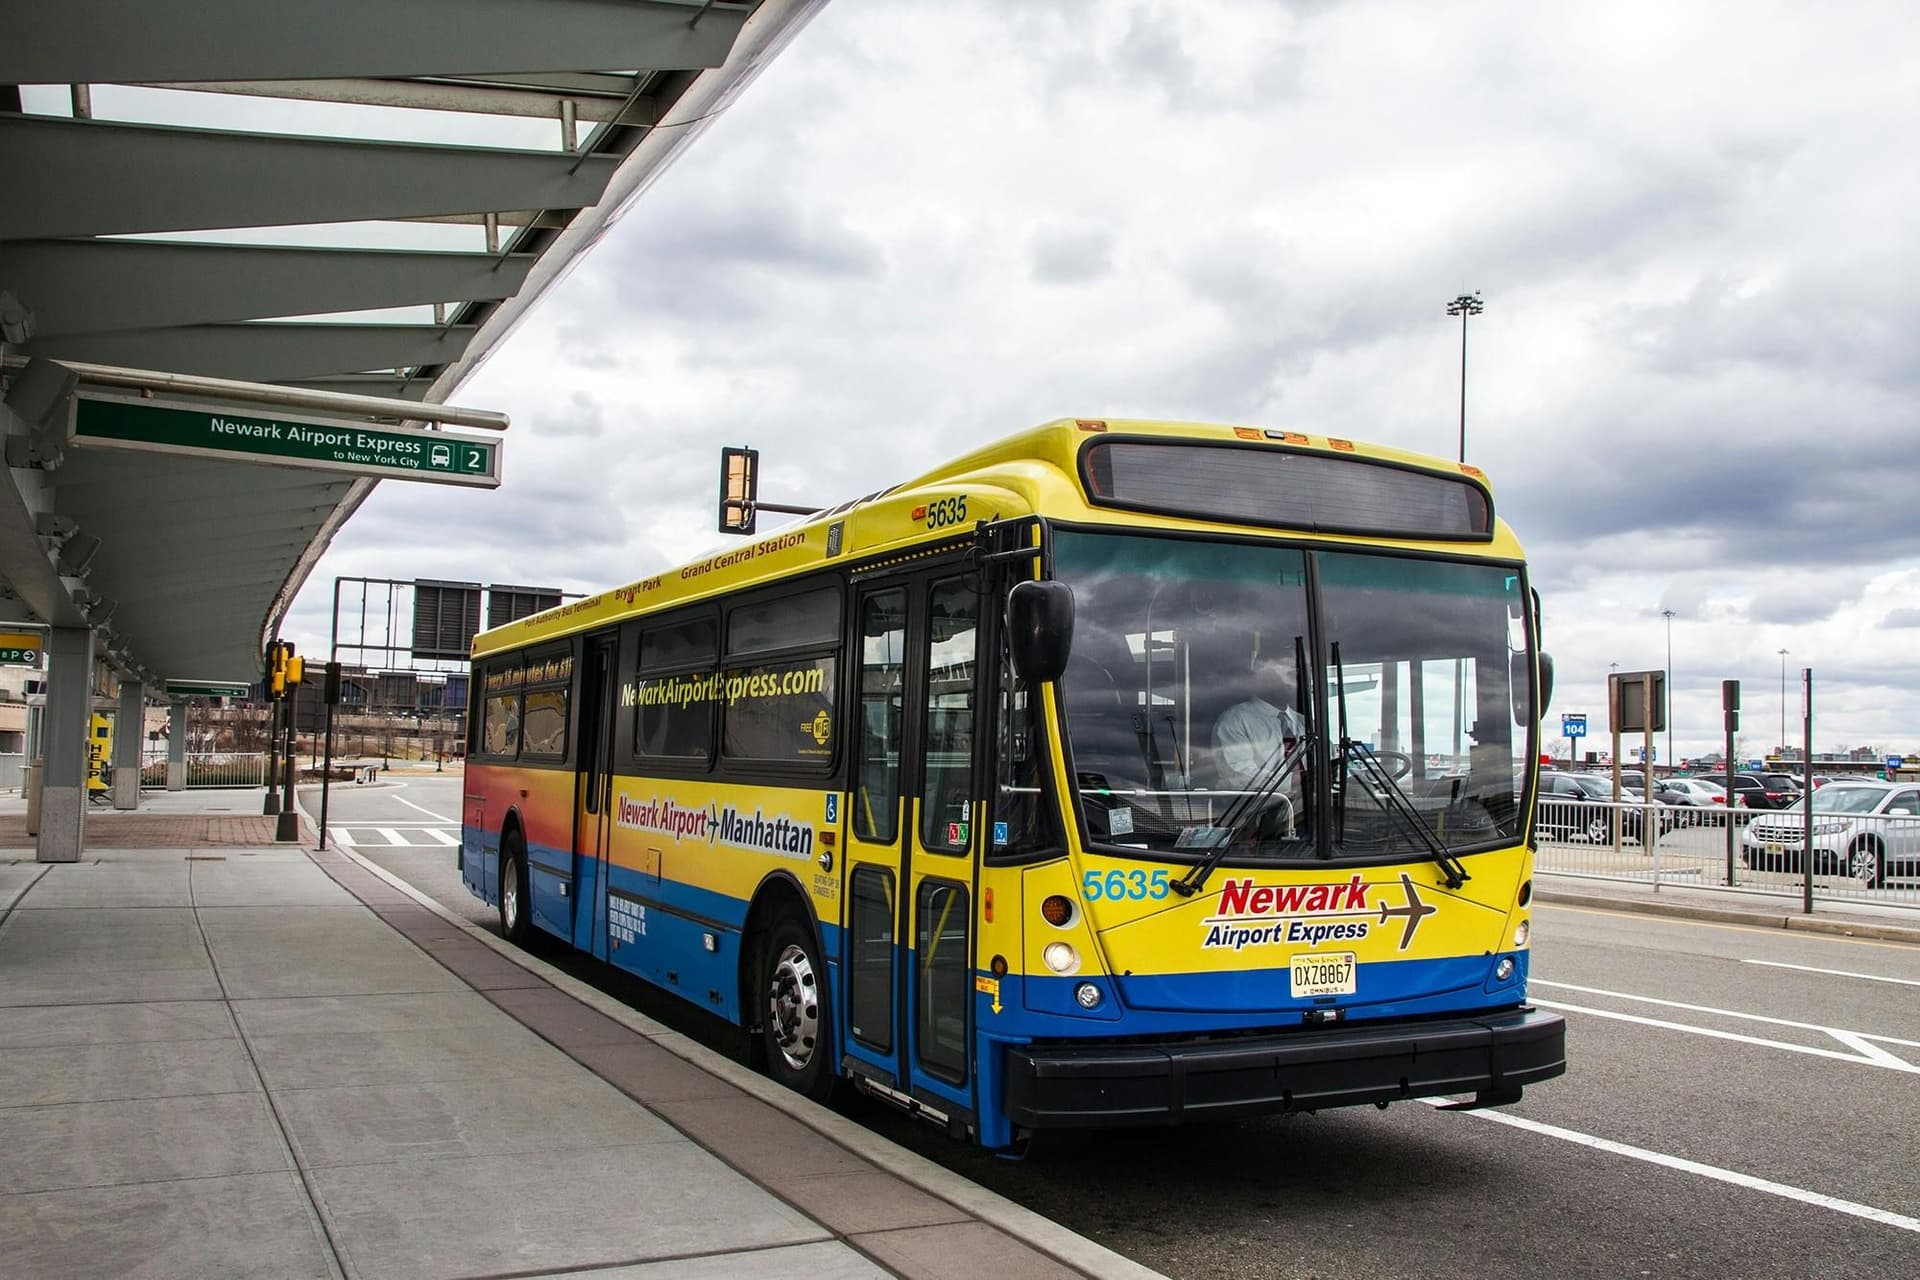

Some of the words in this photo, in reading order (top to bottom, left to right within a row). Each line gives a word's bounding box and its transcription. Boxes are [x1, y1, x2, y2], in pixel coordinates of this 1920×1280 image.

[211, 418, 282, 439] Newark
[287, 427, 351, 447] Airport
[356, 434, 421, 454] Express
[333, 451, 345, 460] to
[347, 451, 371, 462] New
[373, 454, 397, 465] York
[399, 456, 420, 469] City
[467, 451, 480, 468] 2
[927, 495, 967, 529] 5635
[681, 559, 712, 580] Grand
[714, 545, 755, 570] Central
[757, 532, 805, 557] Station
[615, 584, 641, 601] Bryant
[642, 576, 662, 592] Park
[561, 607, 573, 617] Bus
[573, 598, 602, 613] Terminal
[621, 668, 825, 710] NewarkAirportExpress.com
[800, 722, 813, 733] FREE
[1565, 724, 1585, 735] 104
[89, 744, 102, 779] HELP
[618, 796, 659, 829] Newark
[659, 801, 707, 840] Airport
[720, 808, 812, 855] Manhattan
[1082, 870, 1169, 901] 5635
[1218, 876, 1371, 915] Newark
[1205, 924, 1282, 949] Airport
[1287, 921, 1368, 945] Express
